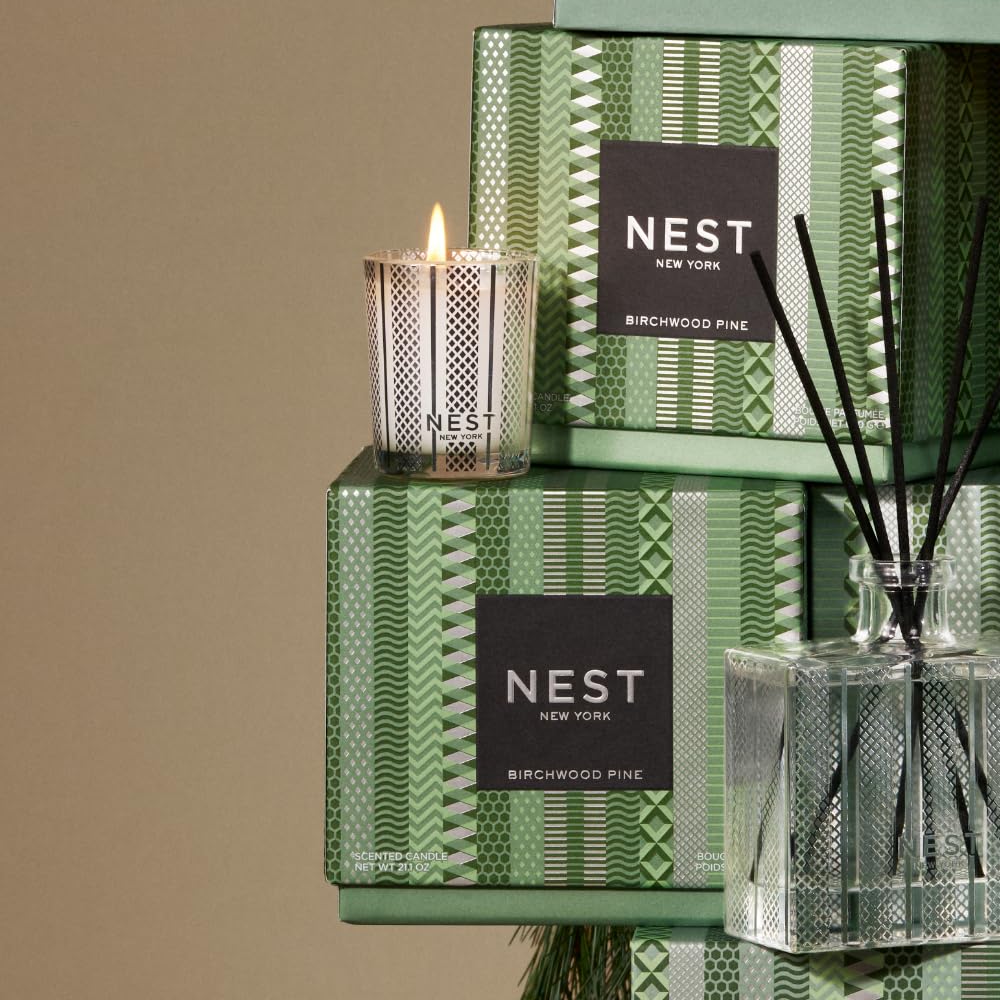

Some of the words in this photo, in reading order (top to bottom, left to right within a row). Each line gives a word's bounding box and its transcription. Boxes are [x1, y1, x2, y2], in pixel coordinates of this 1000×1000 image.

[627, 215, 753, 255] NEST
[656, 259, 683, 269] NEW
[687, 259, 721, 271] YORK
[625, 315, 711, 329] BIRCHWOOD
[716, 319, 749, 331] PINE
[426, 413, 495, 432] NEST
[794, 418, 820, 426] POID
[461, 433, 484, 441] YORK
[507, 669, 645, 703] NEST
[540, 711, 570, 721] NEW
[574, 711, 611, 721] YORK
[508, 769, 602, 780] BIRCHWOOD
[608, 770, 643, 780] PINE
[898, 832, 982, 858] NEST
[354, 852, 403, 861] SCENTED
[405, 852, 448, 861] CANDLE
[354, 863, 375, 872] NET
[378, 863, 396, 872] WT
[398, 863, 414, 872] 21.1
[415, 863, 430, 872] OZ
